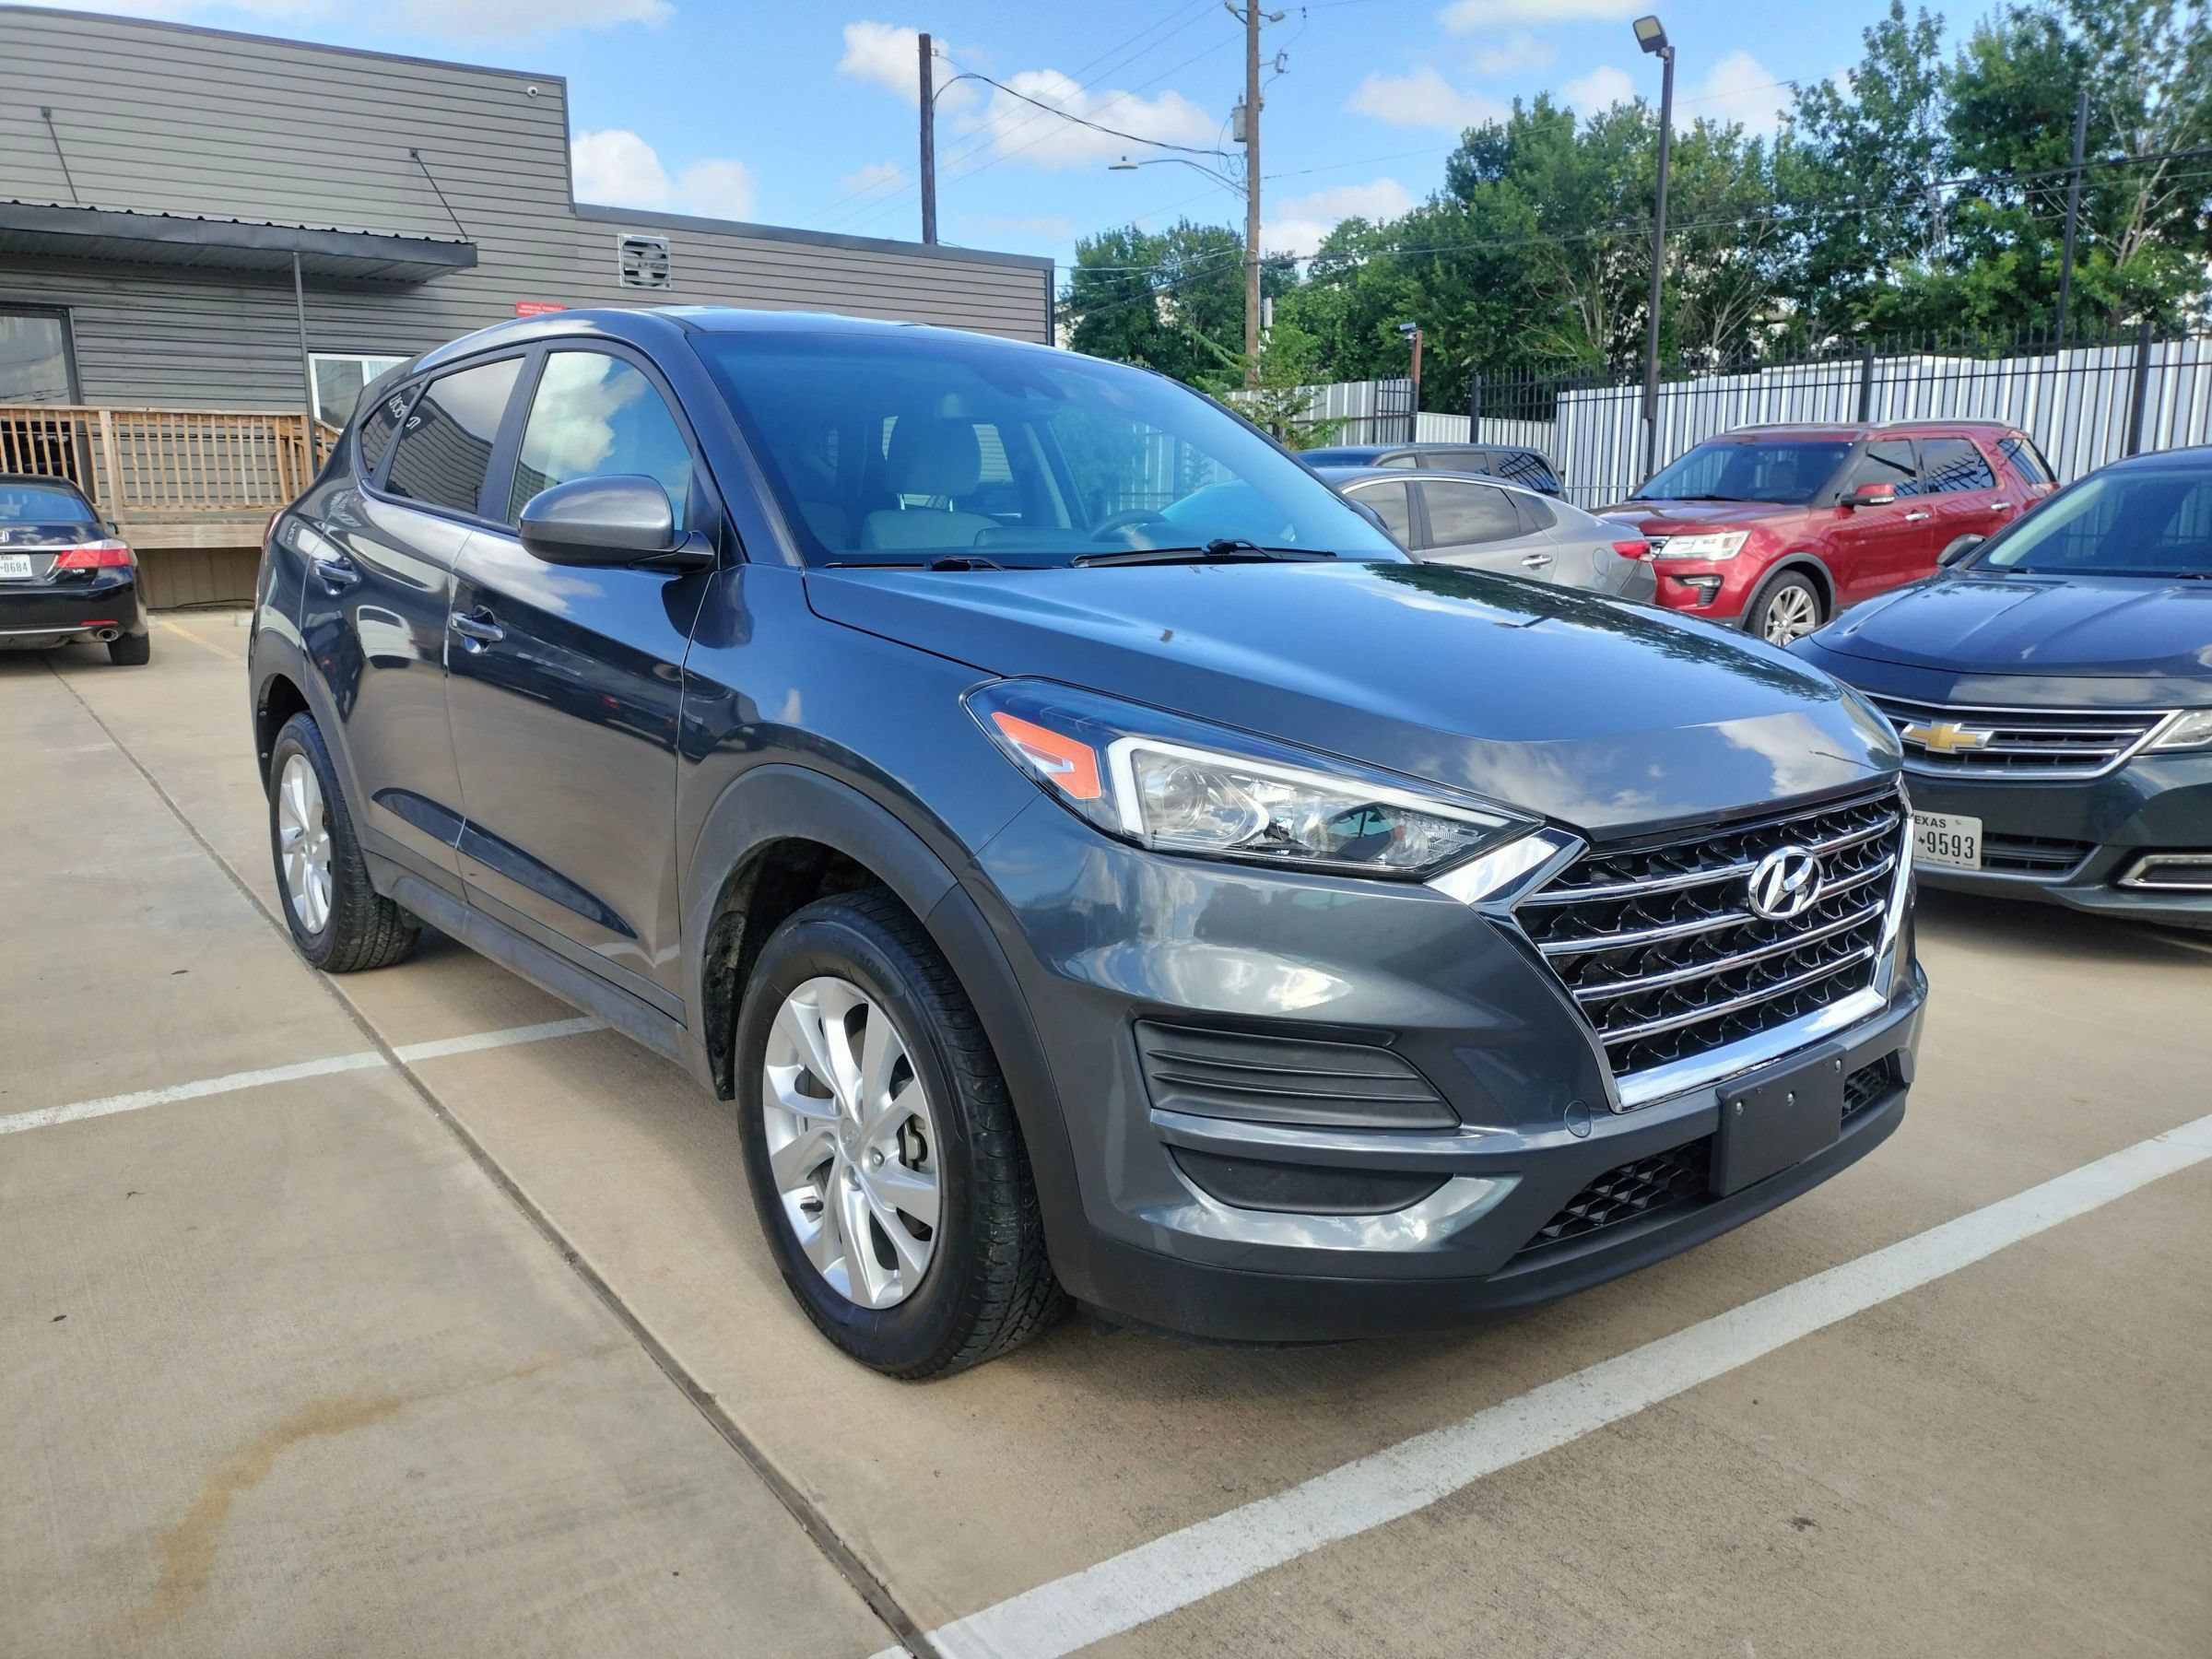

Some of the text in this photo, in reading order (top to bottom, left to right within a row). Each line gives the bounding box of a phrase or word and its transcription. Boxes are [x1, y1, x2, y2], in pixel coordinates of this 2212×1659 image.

[4, 561, 28, 573] 0684
[1914, 815, 1947, 829] EXAS
[1926, 830, 1974, 859] 9593
